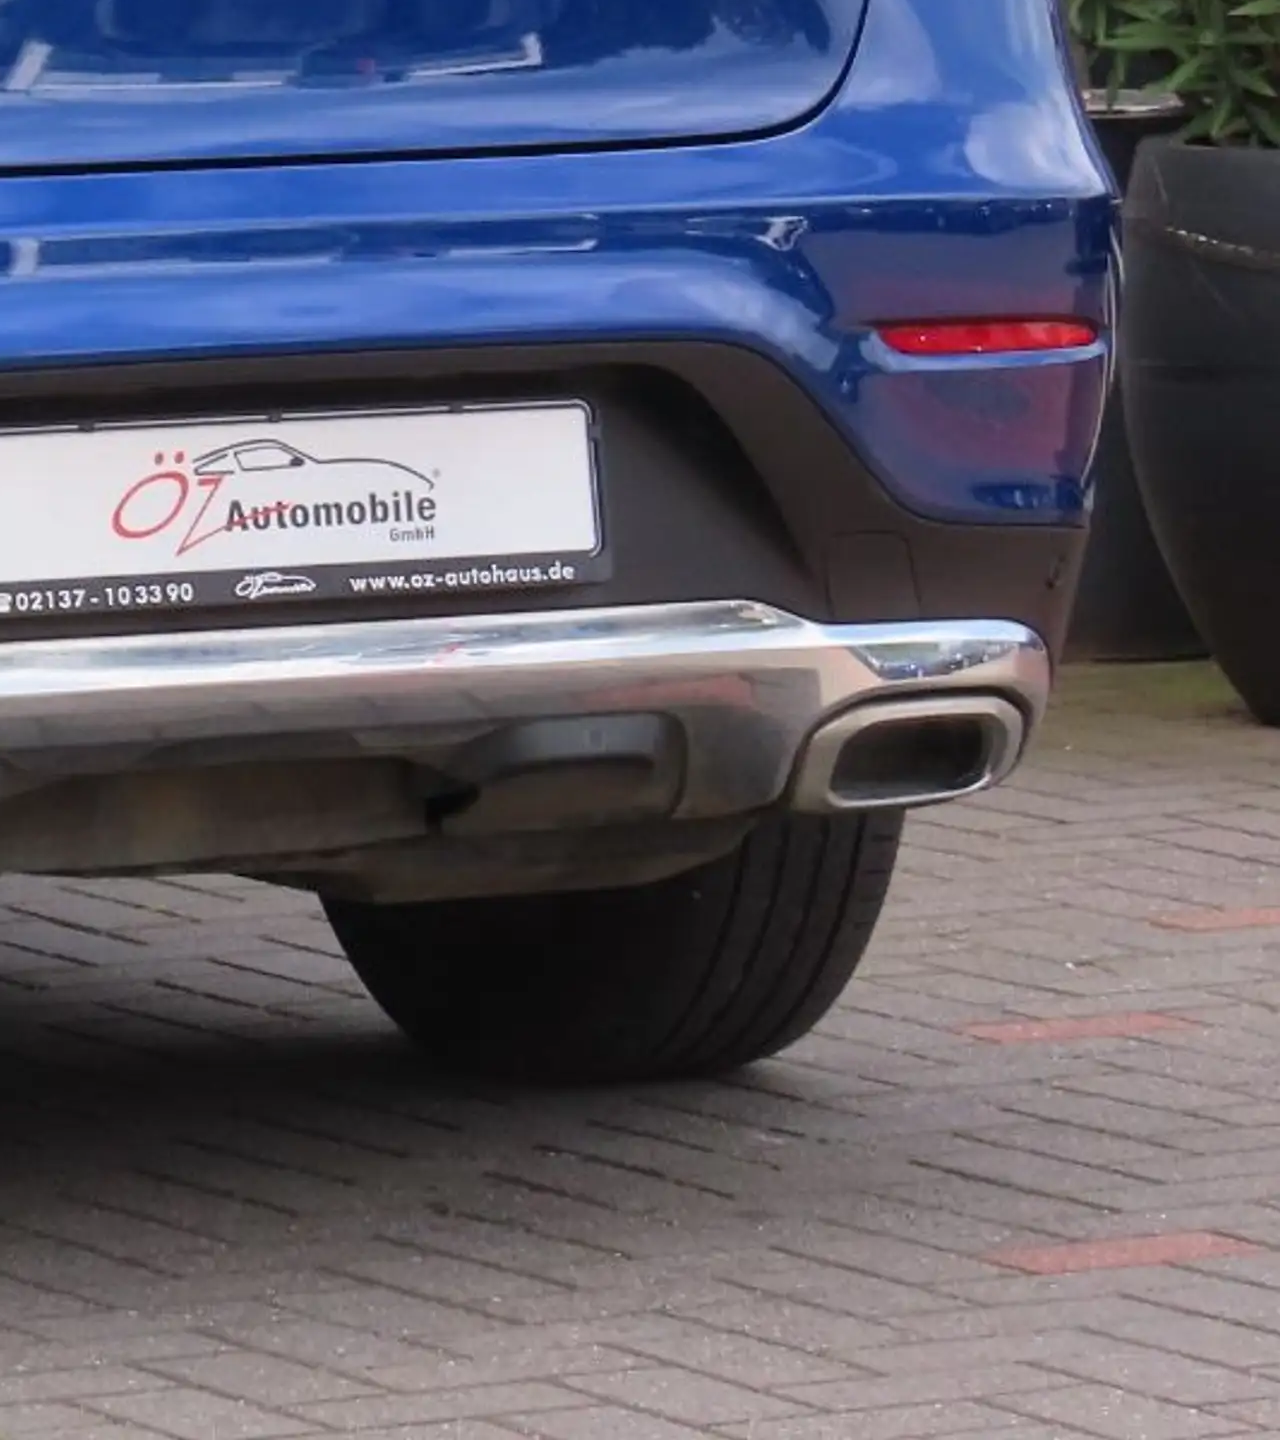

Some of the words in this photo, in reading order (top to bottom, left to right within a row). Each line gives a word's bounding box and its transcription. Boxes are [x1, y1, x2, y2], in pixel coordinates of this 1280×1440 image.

[224, 490, 437, 533] Automobile
[389, 526, 436, 543] GmbH
[349, 560, 575, 593] www.oz-autohaus.de
[15, 588, 87, 612] 02137
